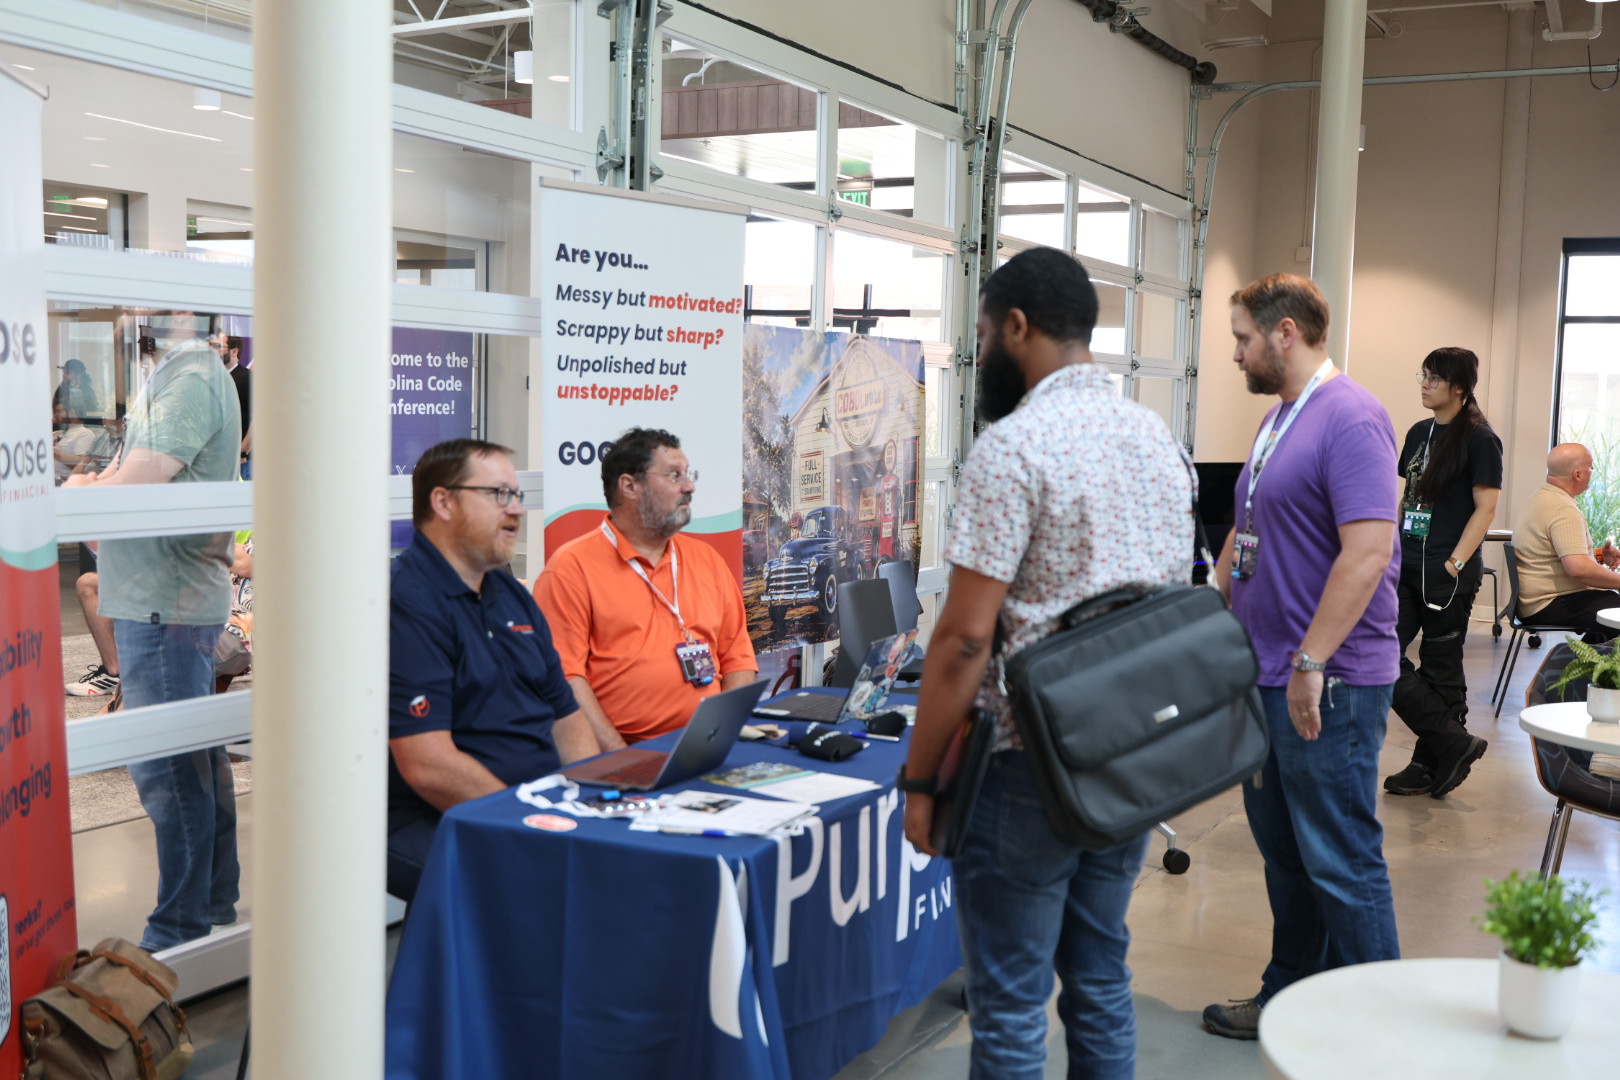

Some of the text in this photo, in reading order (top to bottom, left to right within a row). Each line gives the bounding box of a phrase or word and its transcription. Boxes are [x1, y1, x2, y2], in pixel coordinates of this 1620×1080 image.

[555, 243, 649, 272] Are you...
[556, 283, 743, 314] Messy but motivated?
[556, 319, 724, 350] Scrappy but sharp?
[426, 352, 442, 368] to
[446, 351, 469, 368] the
[557, 354, 687, 378] Unpolished but
[427, 375, 463, 392] Code
[557, 383, 679, 406] unstoppable?
[801, 472, 822, 486] SERVICE
